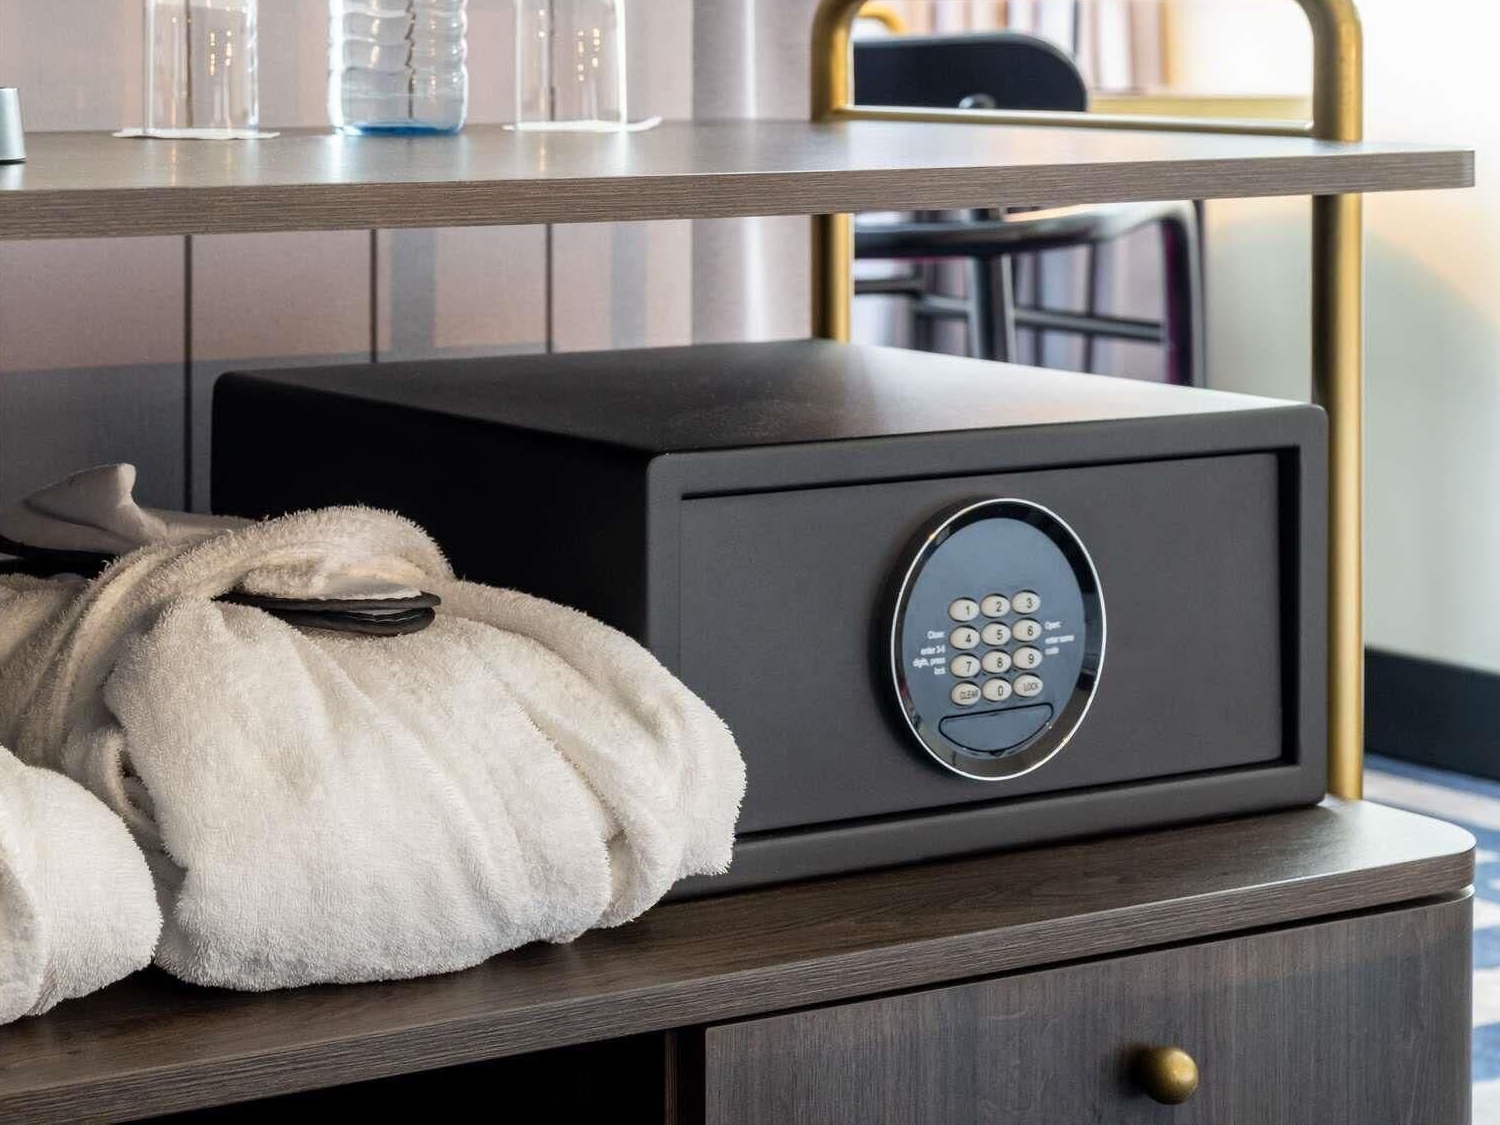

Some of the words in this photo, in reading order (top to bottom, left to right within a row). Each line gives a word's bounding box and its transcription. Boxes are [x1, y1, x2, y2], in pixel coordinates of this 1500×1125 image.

[996, 601, 1003, 612] 2
[1026, 597, 1033, 609] 3
[965, 634, 972, 643] 4
[996, 629, 1003, 640] 5
[1027, 625, 1034, 636] 6
[965, 661, 972, 672] 7
[997, 657, 1003, 668] 8
[1028, 653, 1034, 664] 9
[997, 685, 1004, 696] 0
[1022, 682, 1038, 692] LOCK
